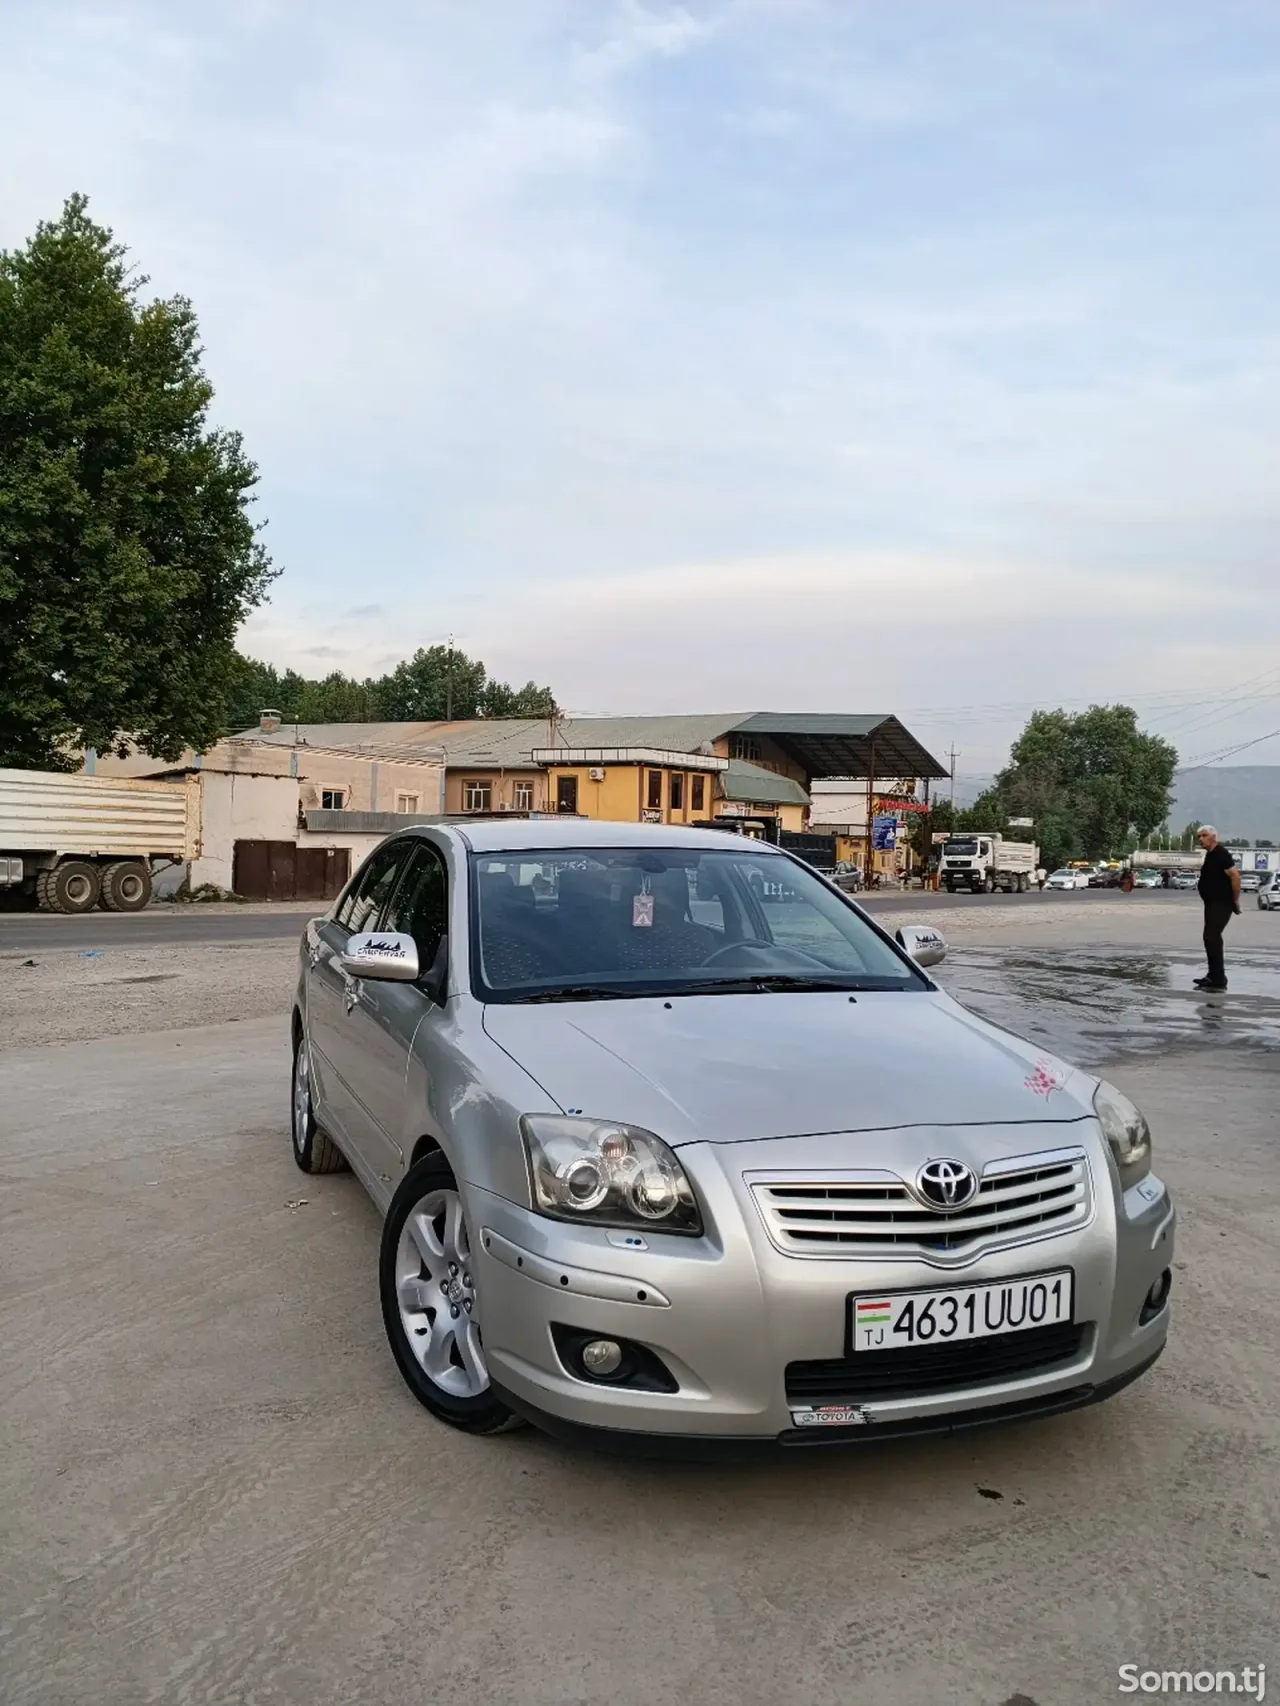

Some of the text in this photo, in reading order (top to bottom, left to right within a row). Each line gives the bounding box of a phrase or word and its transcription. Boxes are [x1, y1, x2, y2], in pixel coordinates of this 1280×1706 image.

[893, 1279, 1062, 1342] 4631UU01
[864, 1328, 884, 1346] TJ
[815, 1412, 856, 1421] TOYOTA
